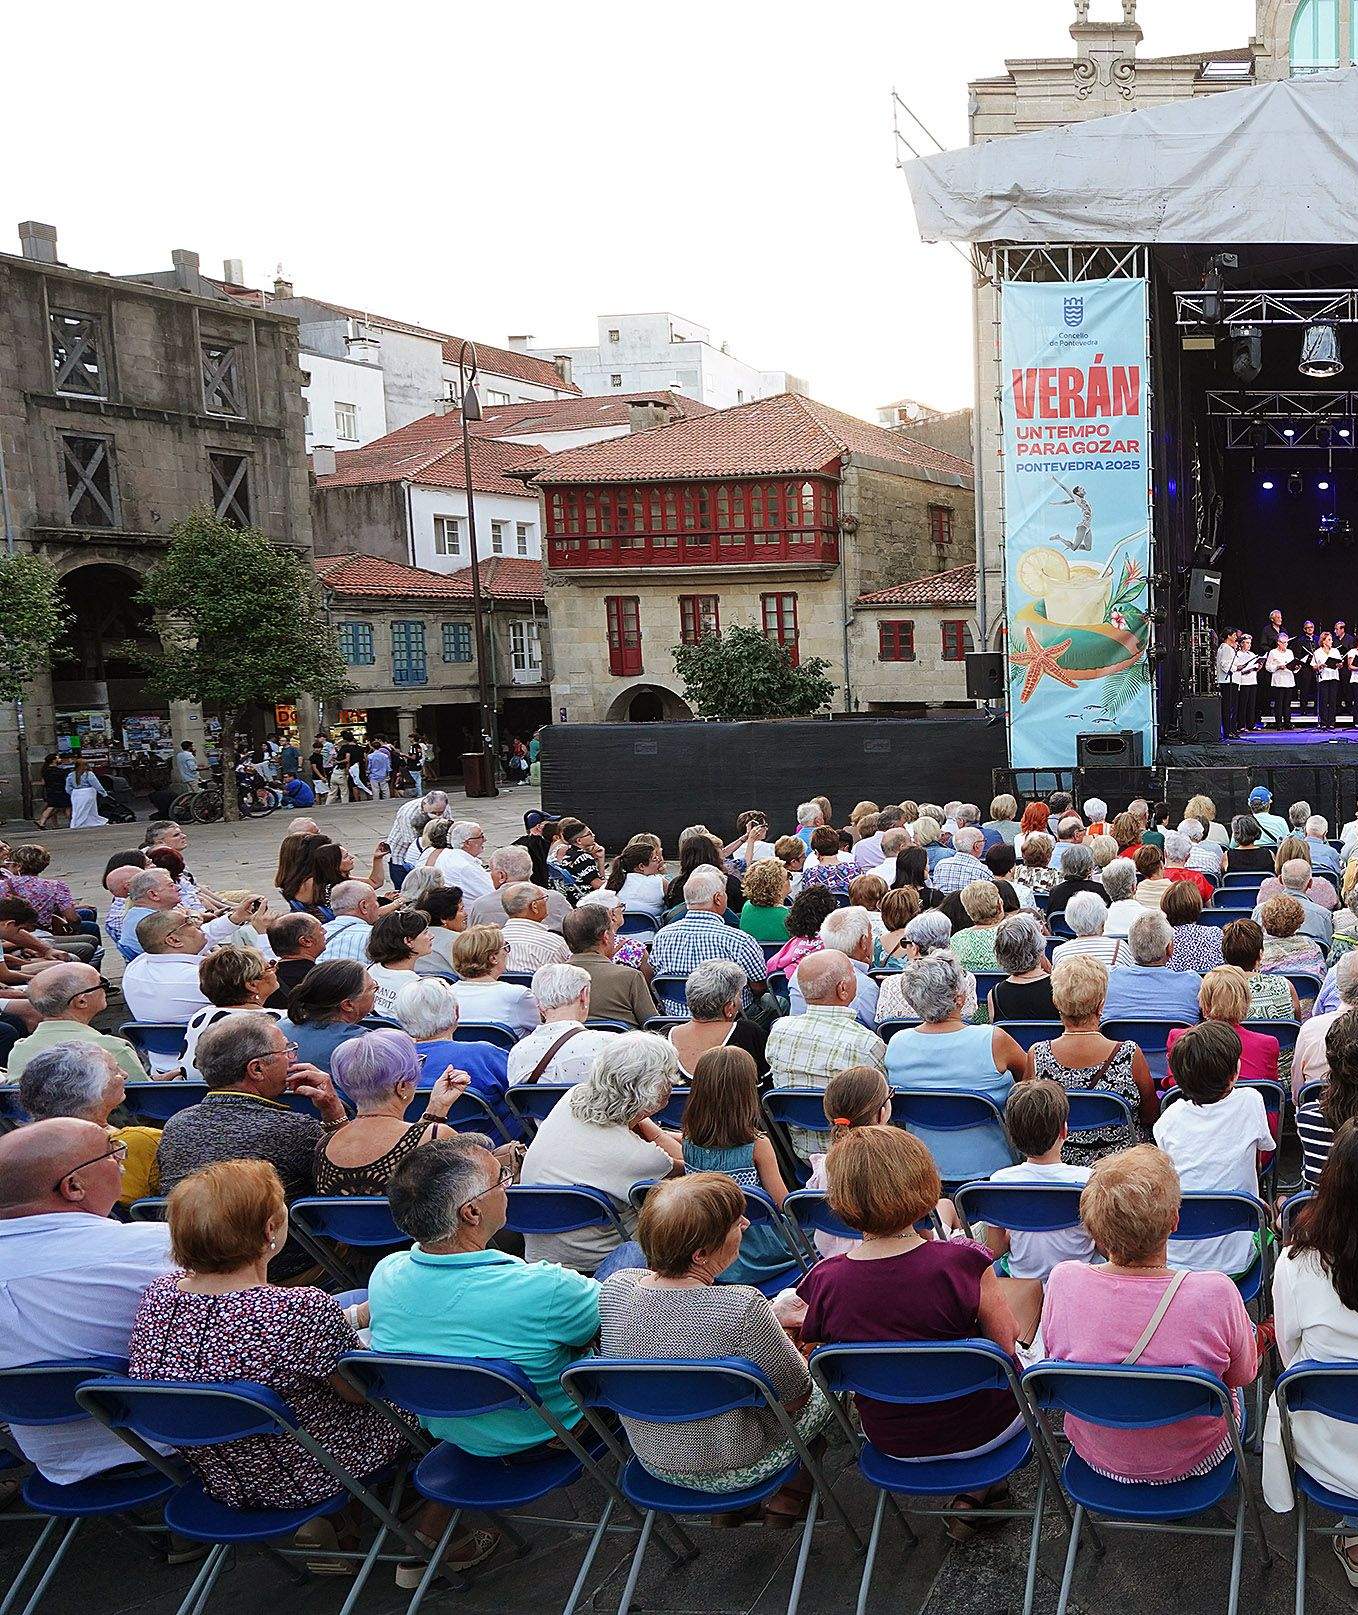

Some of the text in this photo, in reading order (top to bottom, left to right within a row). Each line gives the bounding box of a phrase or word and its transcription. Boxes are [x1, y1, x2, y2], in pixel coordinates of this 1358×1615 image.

[1049, 338, 1098, 347] de Pontevedra
[1058, 332, 1089, 340] Concello
[1012, 353, 1141, 420] VERÁN
[1016, 424, 1110, 440] UN TEMPO
[1017, 439, 1140, 457] PARA GOZAR
[1016, 460, 1141, 473] PONTEVEDRA 2025
